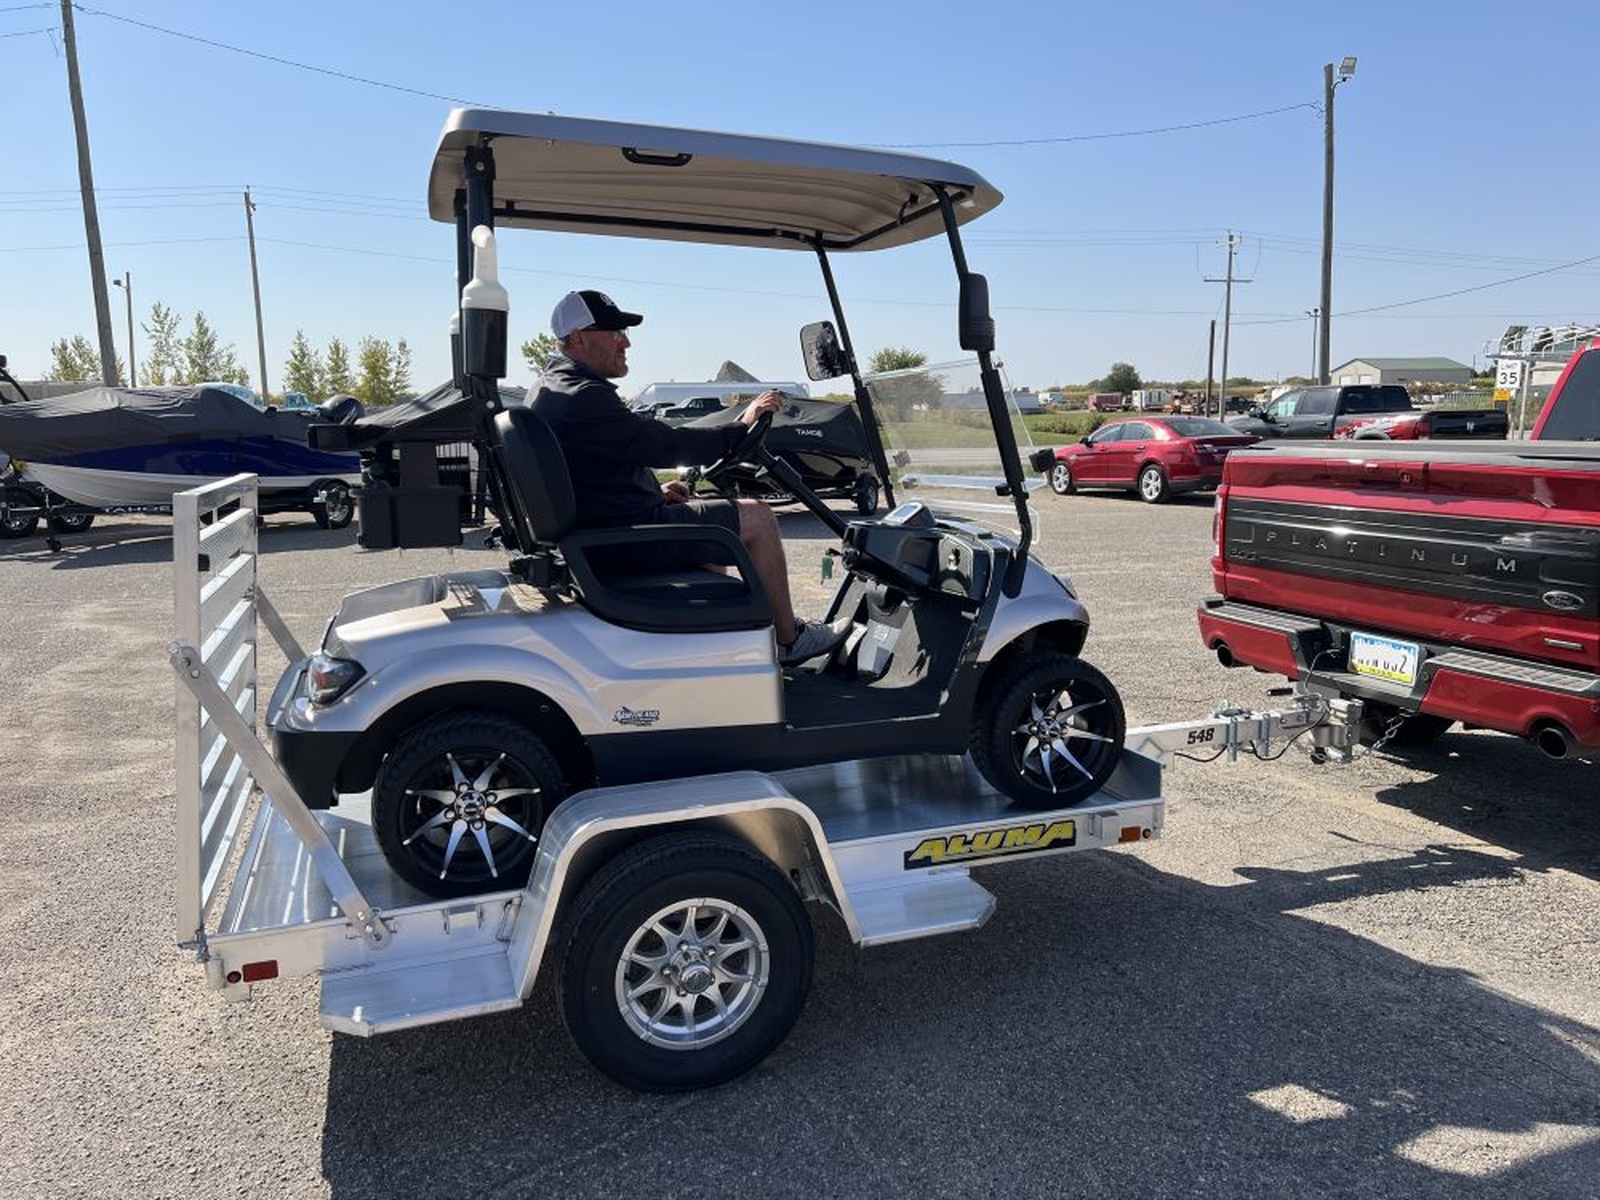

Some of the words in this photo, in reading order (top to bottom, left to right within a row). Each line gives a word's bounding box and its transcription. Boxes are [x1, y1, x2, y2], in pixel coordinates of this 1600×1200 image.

[1499, 372, 1518, 385] 35
[1266, 530, 1517, 573] PLATINUM
[1187, 727, 1215, 745] 548
[906, 820, 1075, 865] ALUMA
